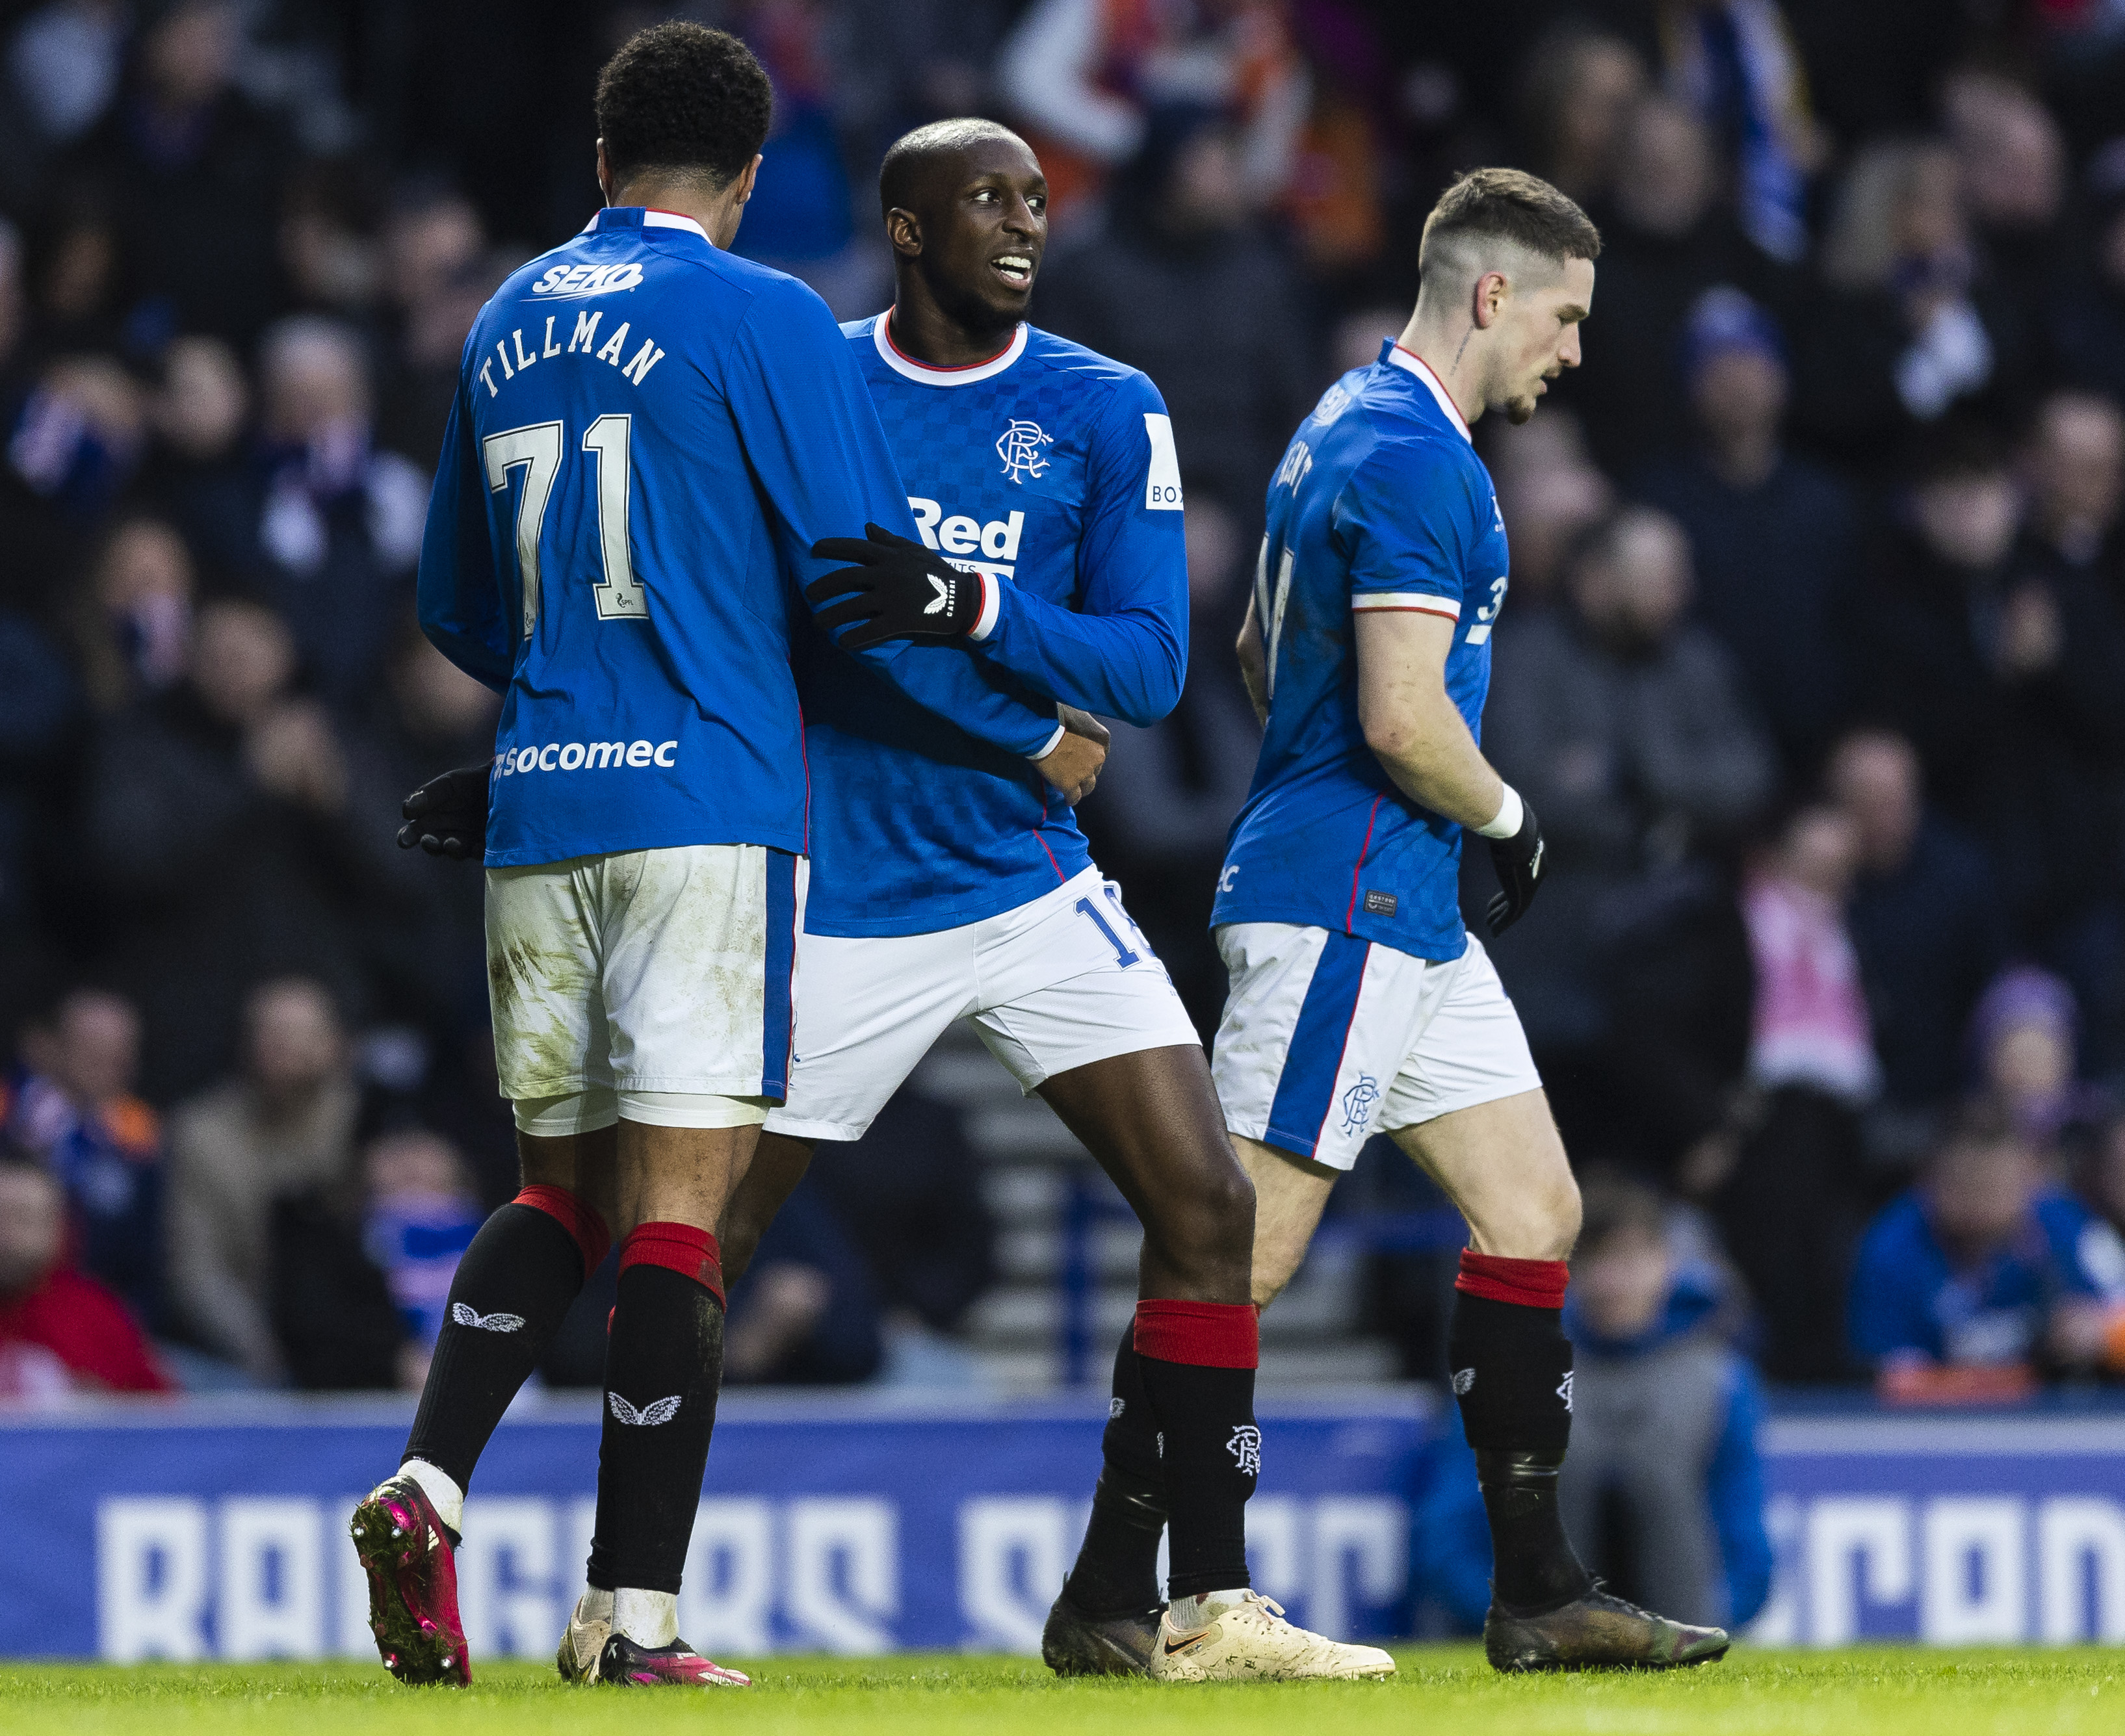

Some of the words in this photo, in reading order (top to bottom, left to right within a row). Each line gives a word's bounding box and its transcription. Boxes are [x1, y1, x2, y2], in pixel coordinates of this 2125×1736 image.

[532, 263, 644, 293] SEKO
[479, 310, 666, 398] TILLMAN
[482, 413, 649, 641] 71
[946, 580, 956, 617] CASTORE
[502, 740, 678, 777] socomec
